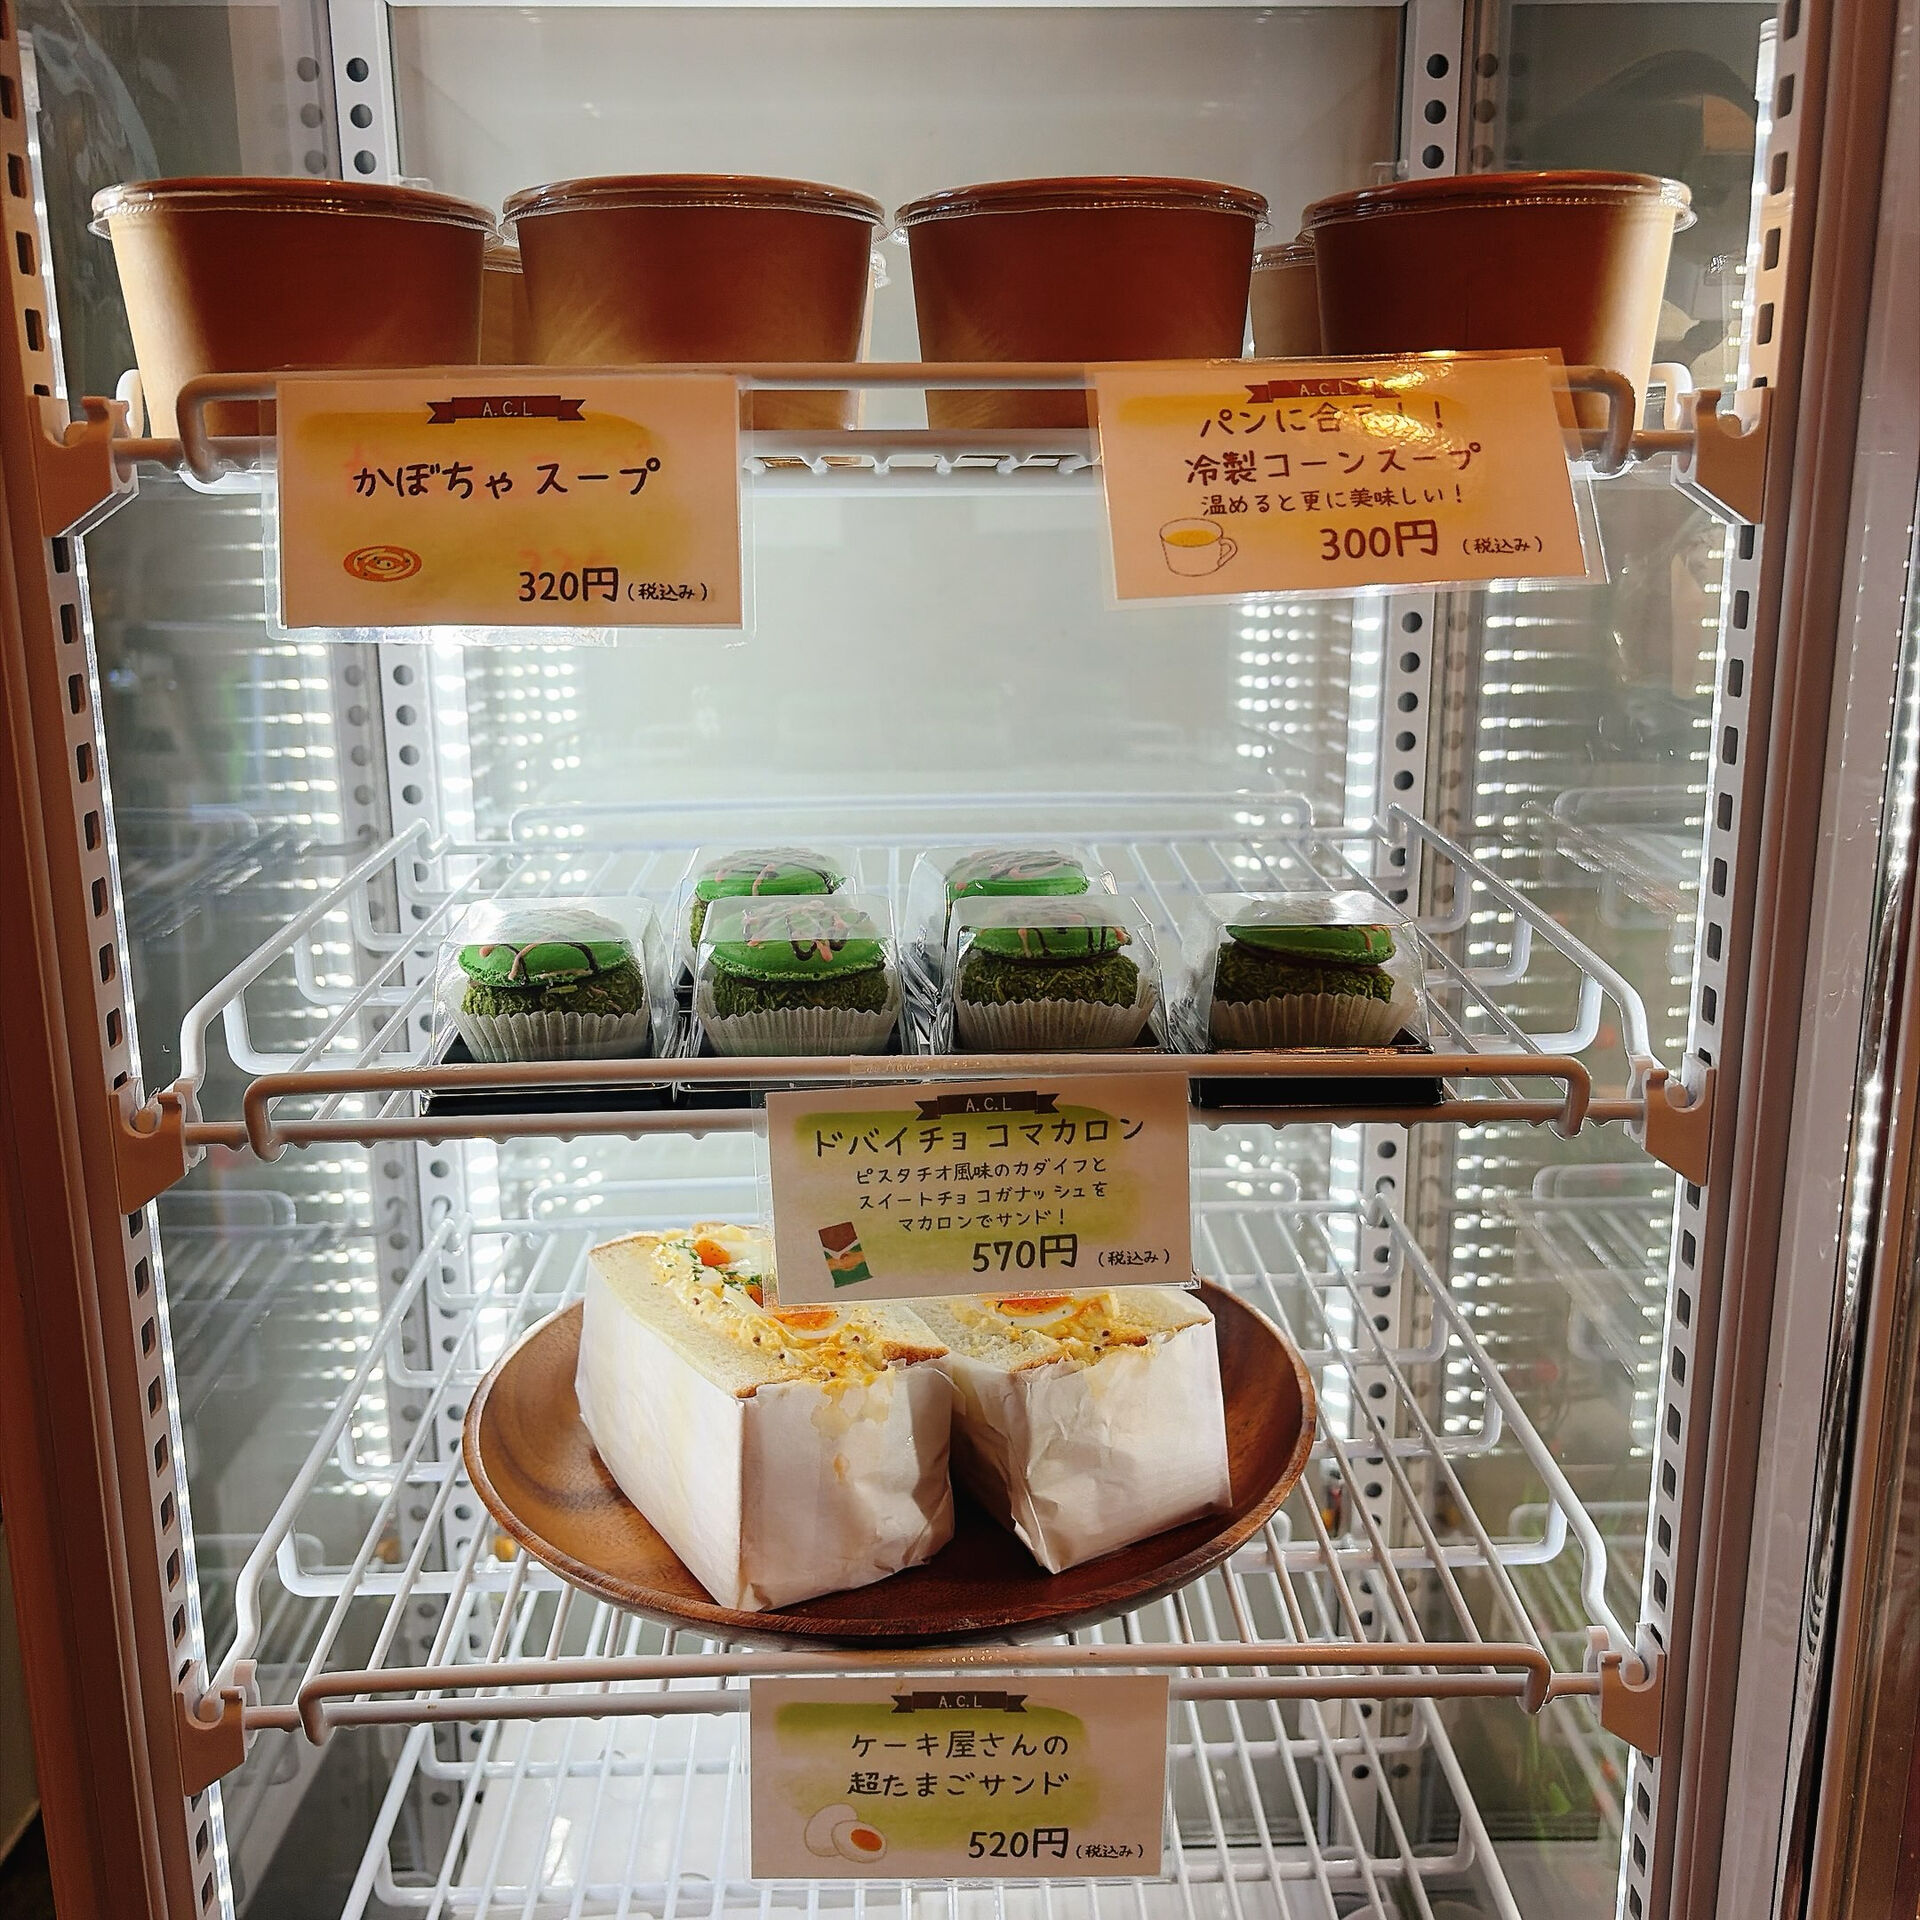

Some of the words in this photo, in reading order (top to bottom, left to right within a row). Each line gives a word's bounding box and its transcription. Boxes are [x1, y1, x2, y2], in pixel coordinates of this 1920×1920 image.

[482, 400, 533, 417] A.C.L
[353, 457, 662, 499] かぼちゃスープ
[1185, 441, 1482, 486] 冷製コーンスープ
[1201, 484, 1464, 517] 温めると更に美味しい！
[1321, 518, 1439, 561] 300円
[518, 566, 619, 602] 320円
[965, 1097, 1012, 1112] A.C.L
[815, 1118, 1145, 1157] ドバイチョコマカロン
[857, 1157, 1108, 1185] ピスタチオ風味のカダイフと
[859, 1182, 1108, 1210] スイートチョコガナッシュを
[898, 1210, 1066, 1232] マカロンでサンド！
[972, 1233, 1078, 1273] 570円
[940, 1695, 983, 1709] A.C.L
[850, 1730, 1069, 1758] ケーキ屋さんの
[846, 1771, 1070, 1797] 超たまごサンド
[968, 1828, 1069, 1859] 520円
